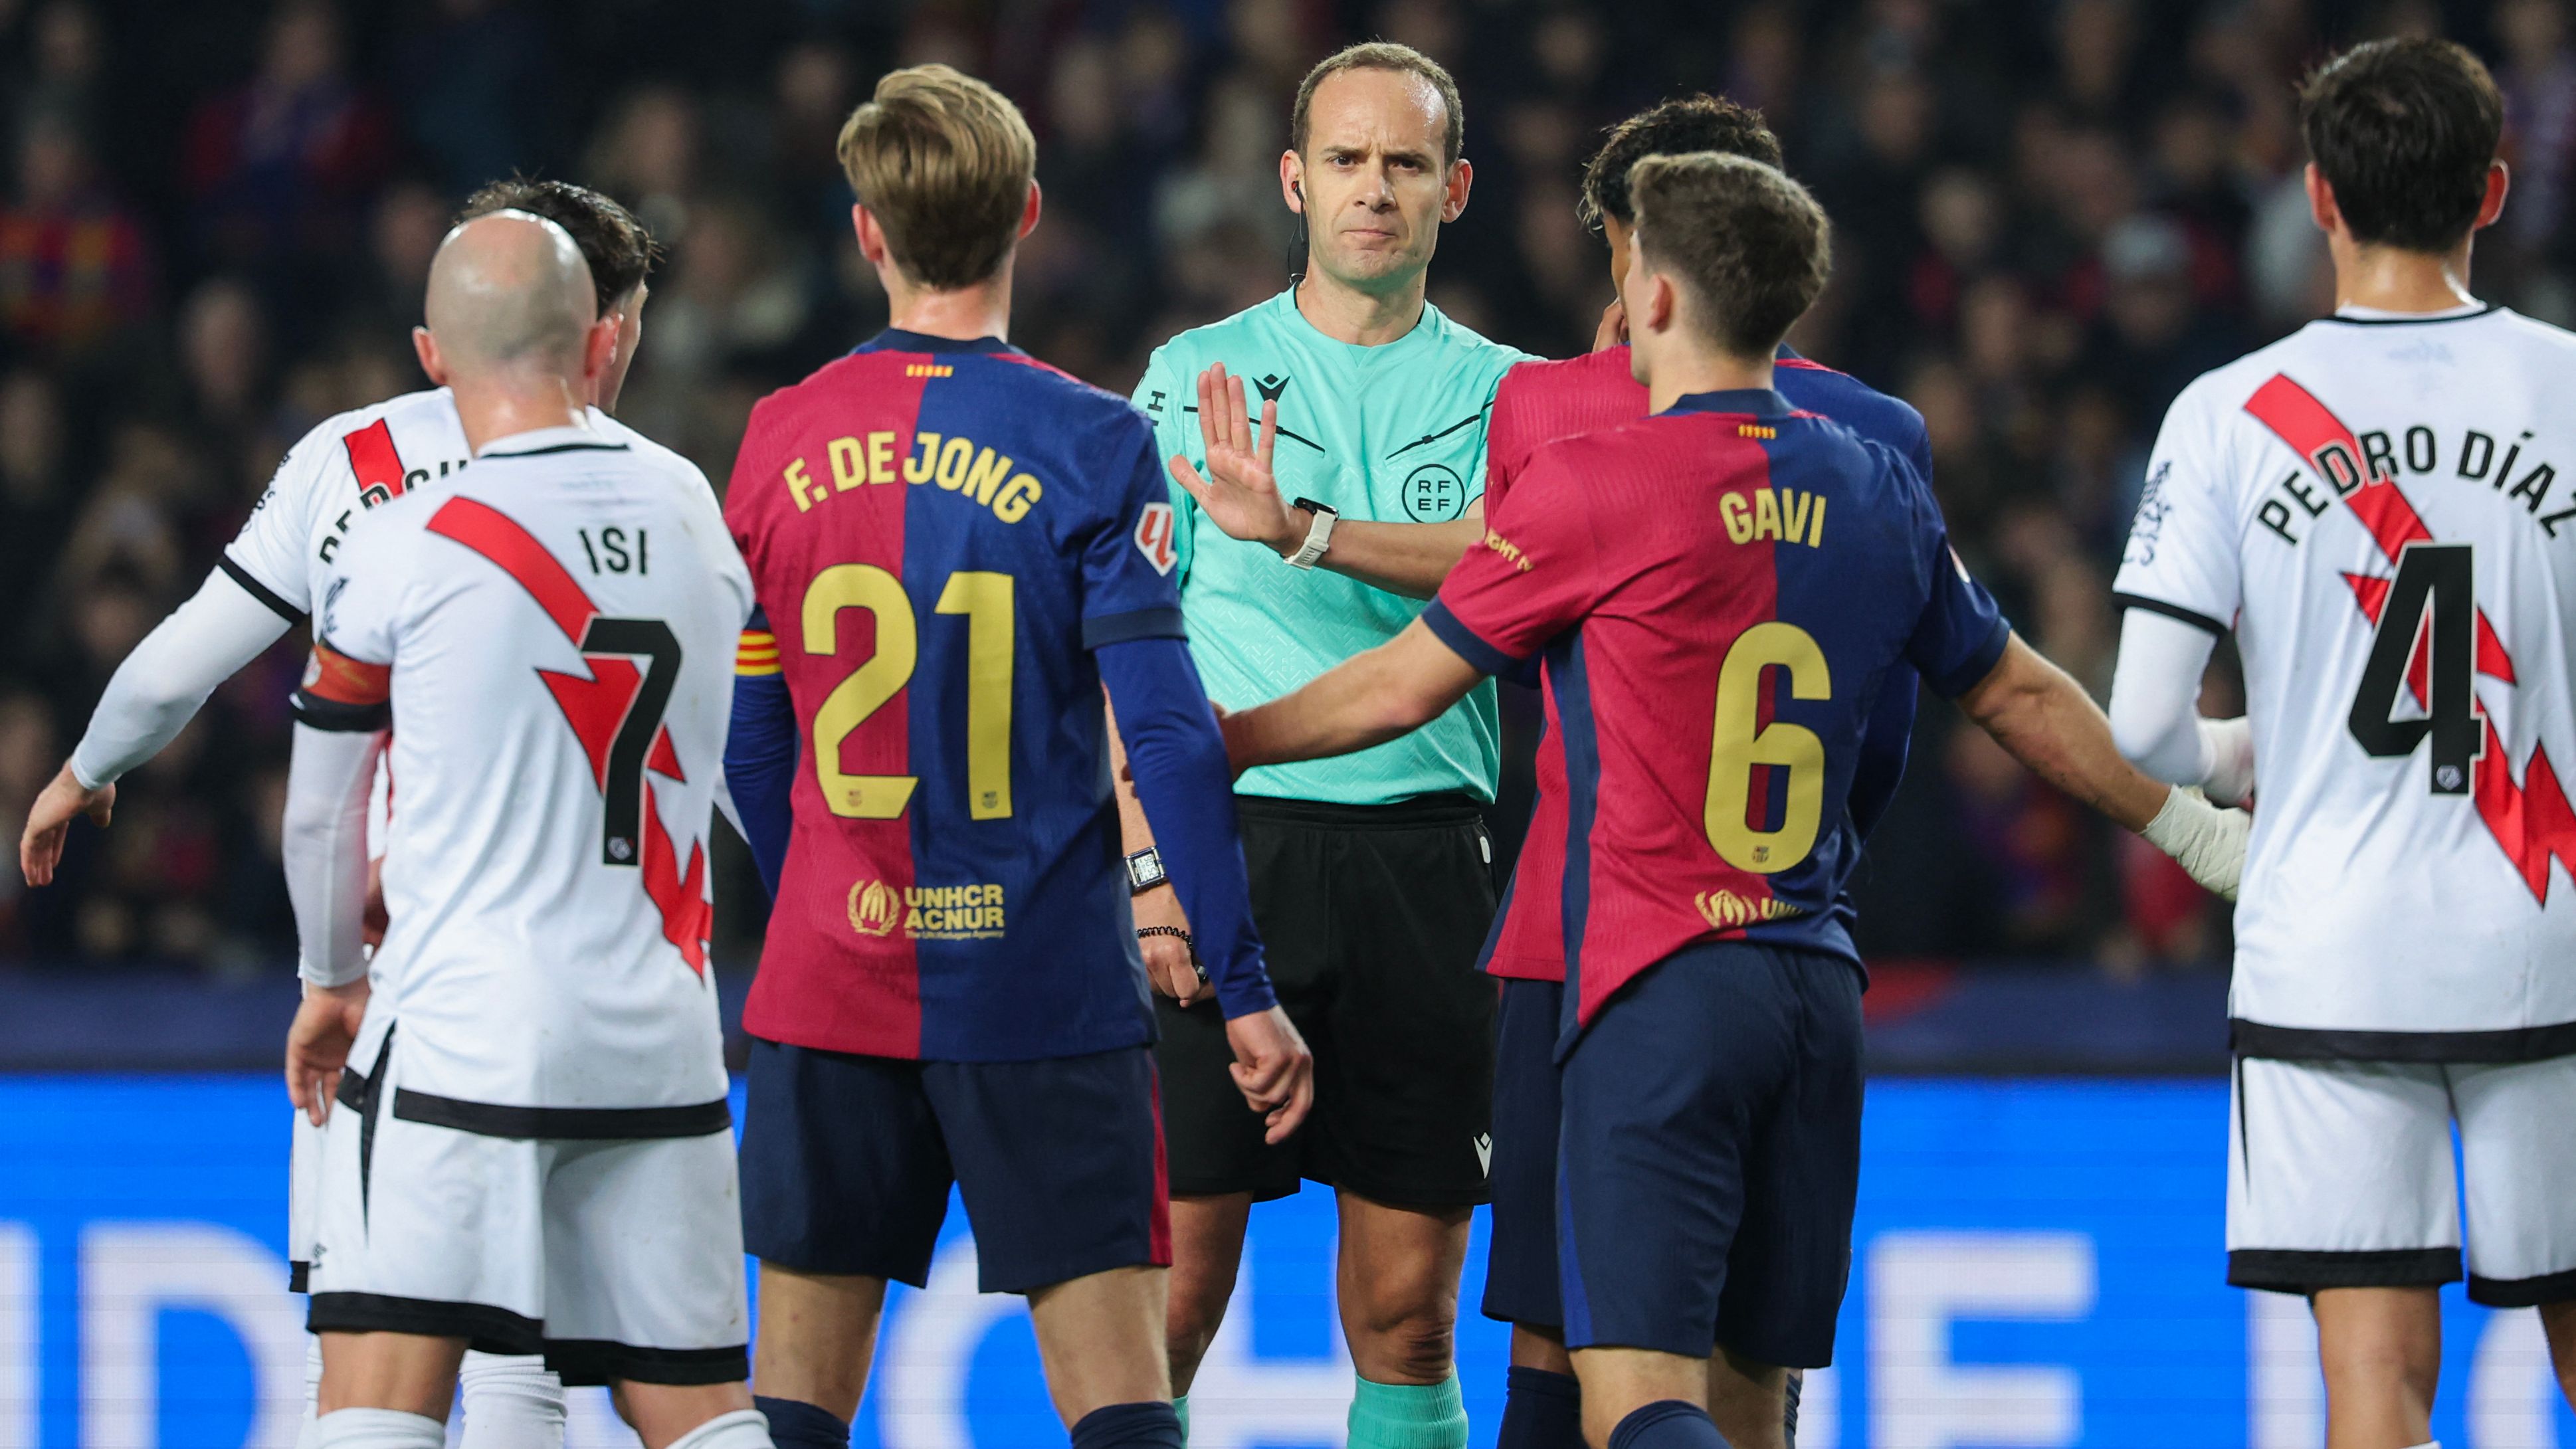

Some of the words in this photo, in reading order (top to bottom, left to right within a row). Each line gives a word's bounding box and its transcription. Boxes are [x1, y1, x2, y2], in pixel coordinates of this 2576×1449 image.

[783, 456, 829, 513] F.
[827, 431, 896, 493] DE
[902, 431, 1043, 525] JONG
[1719, 486, 1827, 549] GAVI
[2258, 426, 2437, 547] PEDRO
[579, 528, 646, 575] ISI
[800, 563, 1014, 821] 21
[2348, 544, 2484, 796] 4
[579, 616, 682, 866] 7
[1703, 621, 1832, 874] 6
[904, 884, 1004, 908] UNHCR
[904, 906, 1005, 930] ACNUR
